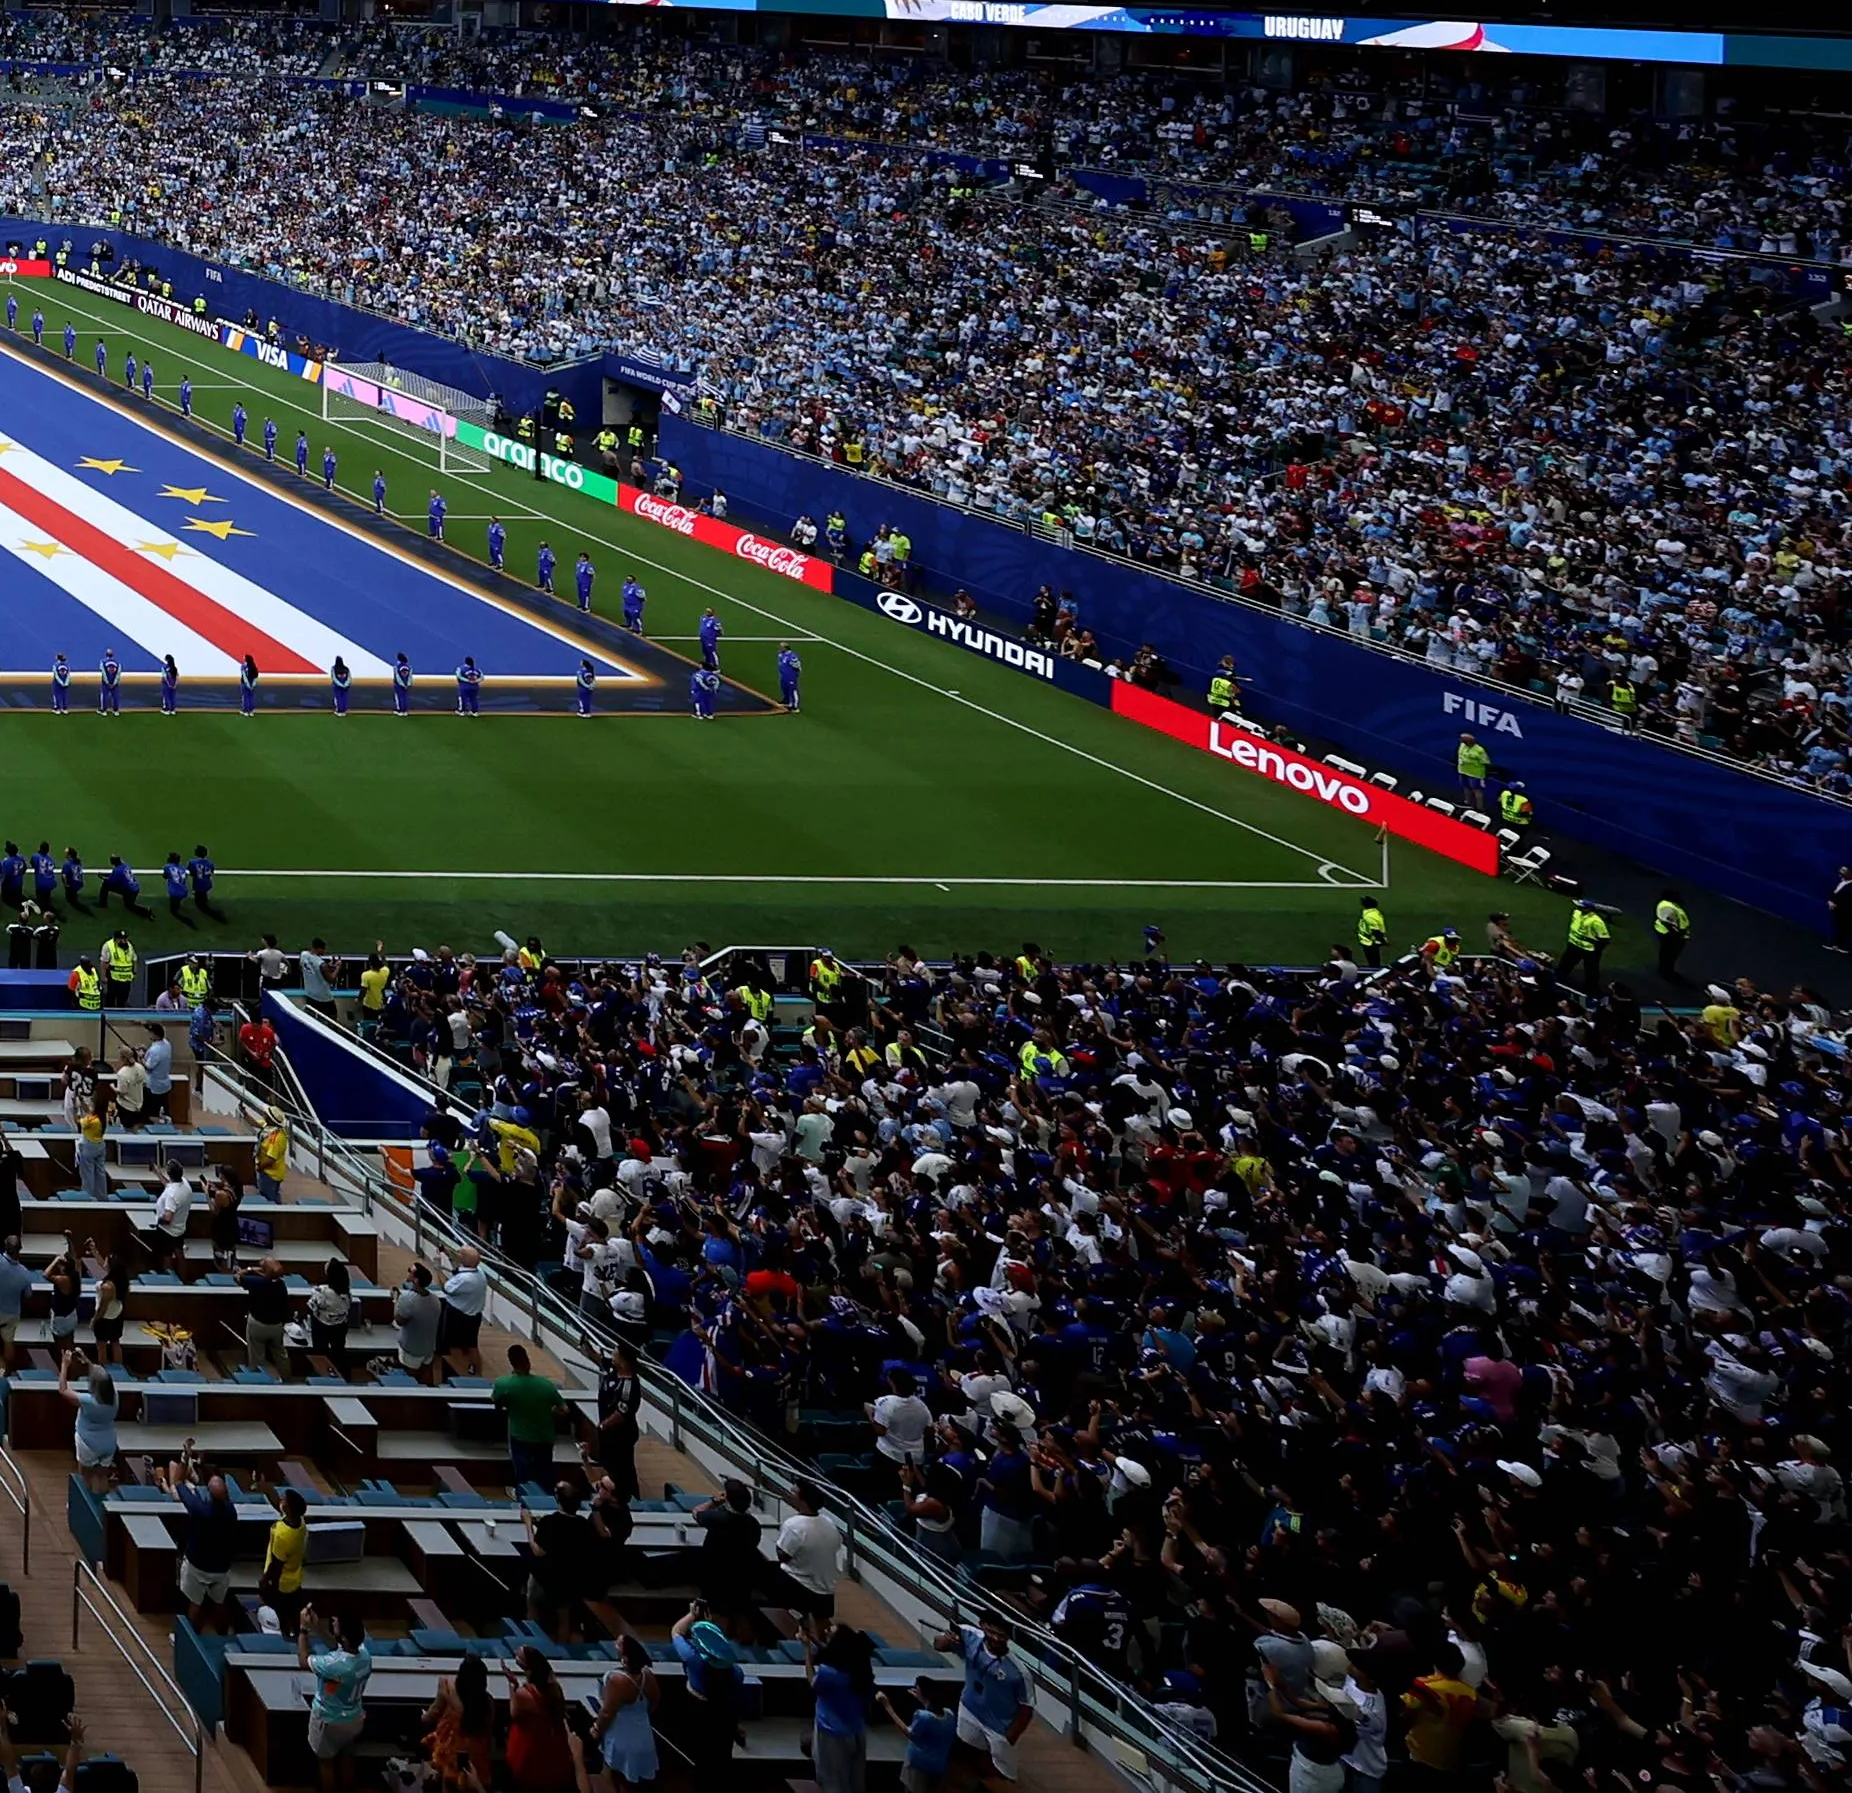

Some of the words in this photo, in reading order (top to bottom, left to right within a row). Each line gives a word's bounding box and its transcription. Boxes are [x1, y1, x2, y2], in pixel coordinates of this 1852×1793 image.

[951, 3, 983, 20] CABO
[986, 4, 1025, 22] VERDE
[1265, 17, 1344, 39] URUGUAY
[57, 268, 76, 285] ADI
[76, 275, 132, 304] PREDICTSTREET
[206, 268, 223, 283] FIFA
[138, 296, 172, 322] QATAR
[175, 309, 219, 340] AIRWAYS
[255, 339, 288, 370] VISA
[620, 366, 636, 378] FIFA
[634, 493, 697, 535] Coca-Cola
[736, 533, 808, 580] Coca-Cola
[928, 610, 1054, 679] HYUNDAI
[1443, 691, 1524, 739] FIFA
[1209, 721, 1370, 814] Lenovo
[1103, 1623, 1125, 1650] 3
